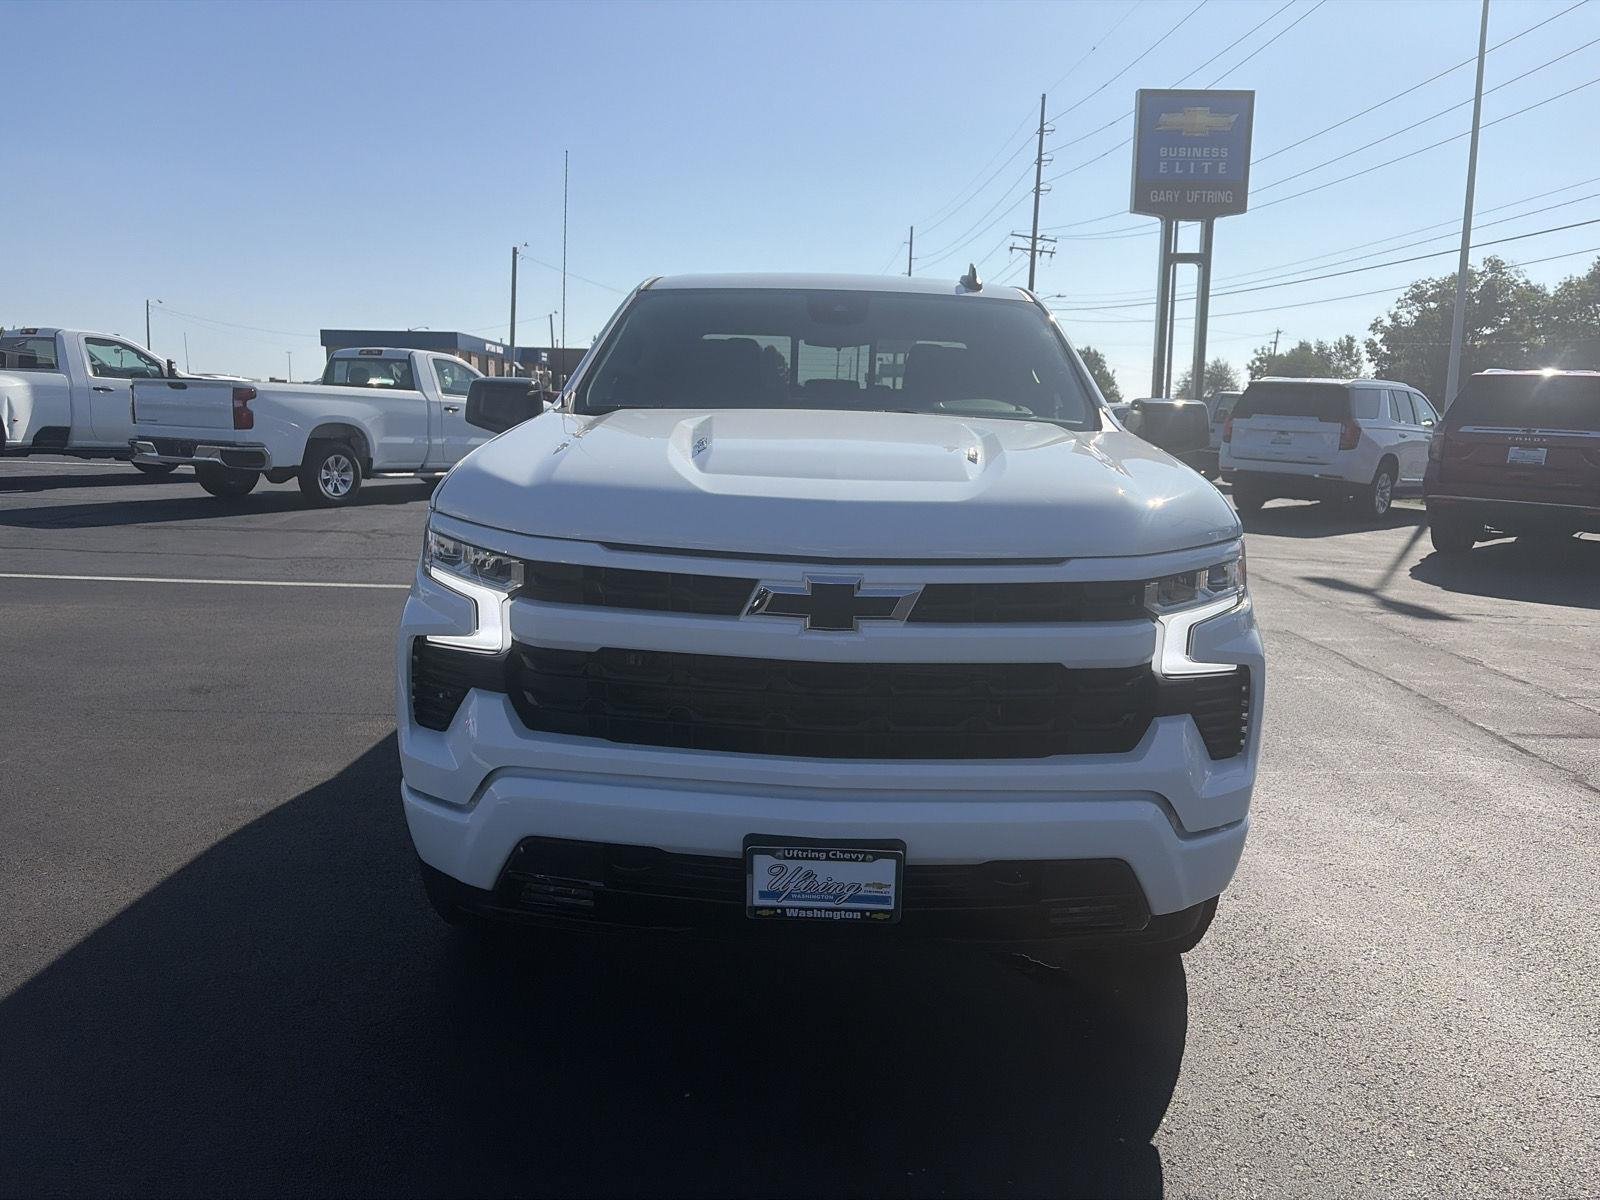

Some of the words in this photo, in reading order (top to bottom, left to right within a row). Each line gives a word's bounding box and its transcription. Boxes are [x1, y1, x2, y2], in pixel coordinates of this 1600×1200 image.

[1159, 146, 1229, 158] BUSINESS
[1159, 161, 1228, 174] ELITE
[1150, 190, 1180, 203] GARY
[1186, 190, 1233, 204] UFTRING
[785, 849, 826, 861] Uftring
[828, 850, 865, 862] Chevy
[767, 863, 863, 905] Uftring
[791, 893, 834, 901] WASHINGTON
[785, 907, 861, 920] Washington
